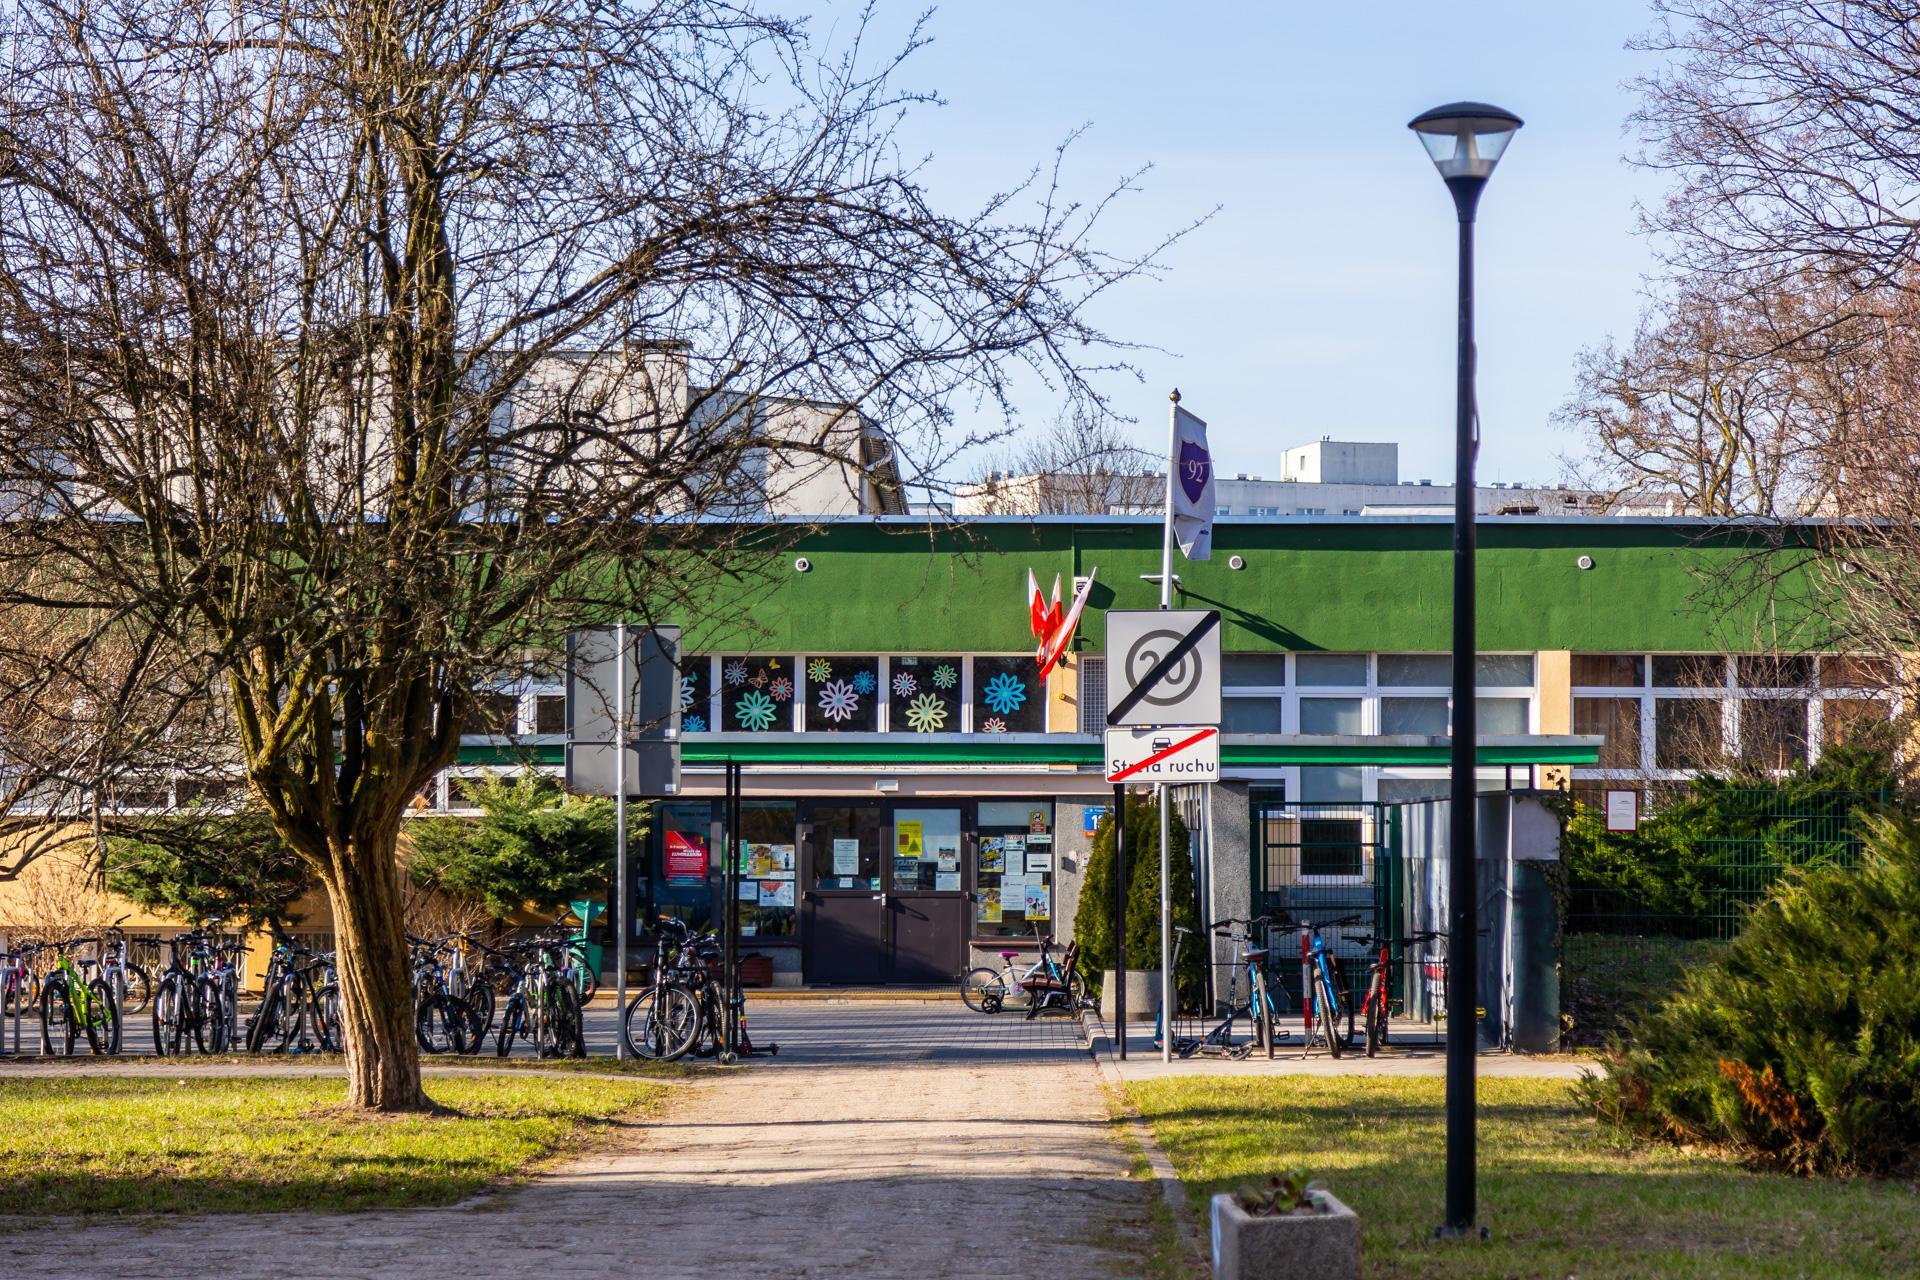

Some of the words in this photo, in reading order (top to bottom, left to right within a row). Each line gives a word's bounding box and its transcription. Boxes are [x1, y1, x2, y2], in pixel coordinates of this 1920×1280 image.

[1187, 459, 1204, 483] 92
[1111, 759, 1161, 773] Sta
[1169, 758, 1215, 773] ruchu
